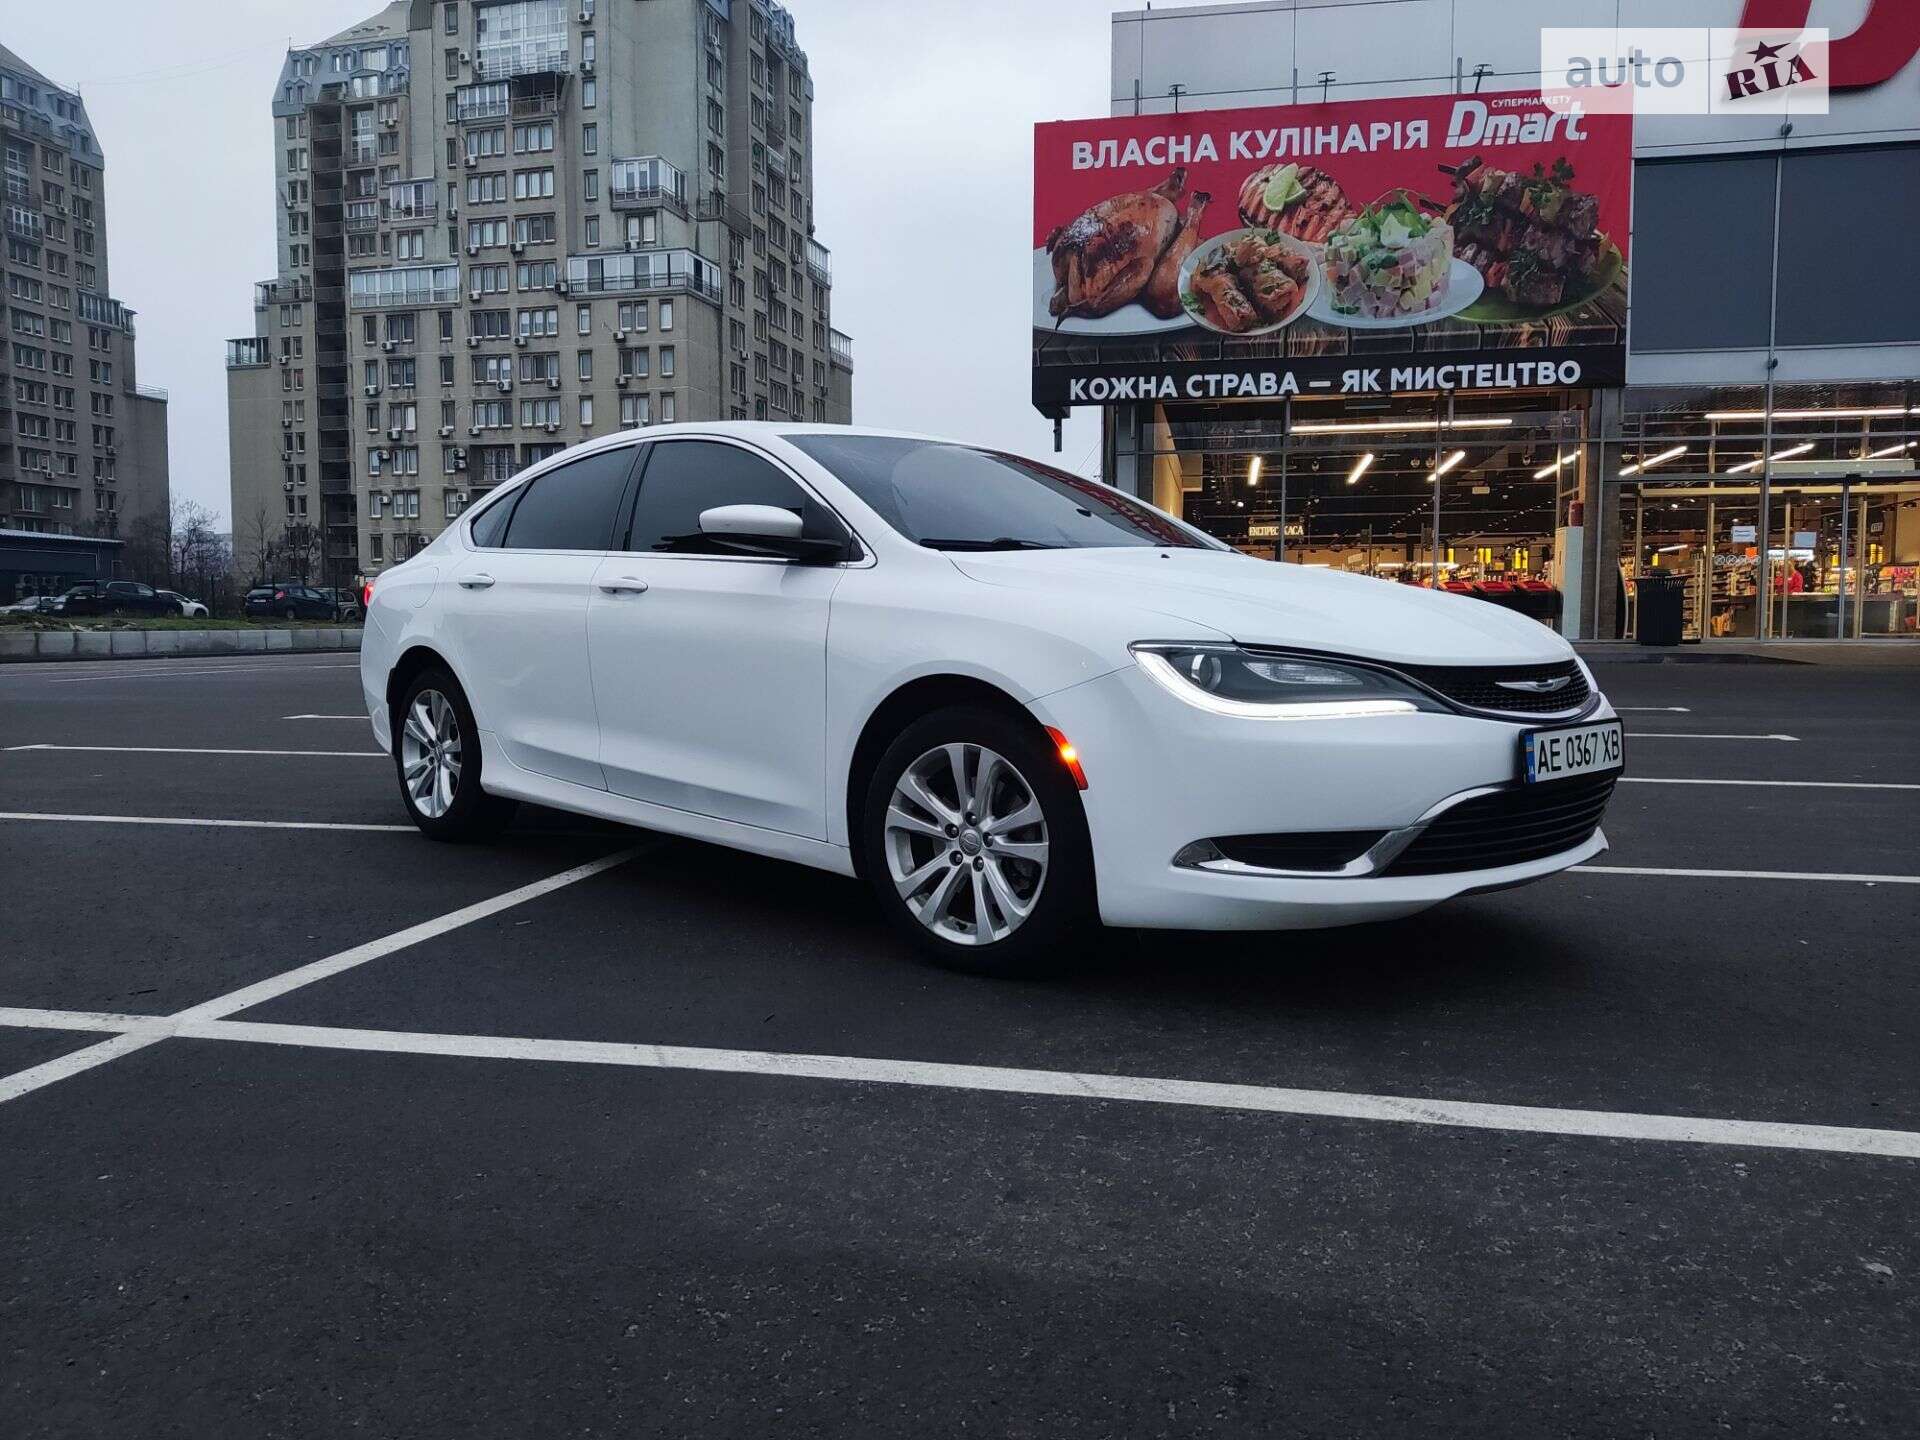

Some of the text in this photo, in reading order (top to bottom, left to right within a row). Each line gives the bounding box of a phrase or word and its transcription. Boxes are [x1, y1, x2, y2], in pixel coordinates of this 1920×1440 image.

[1491, 95, 1572, 108] СУПЕРМАРКЕТУ
[1072, 119, 1429, 170] ВЛАСНА КУЛІНАРІЯ
[1069, 375, 1178, 401] КОЖНА
[1186, 371, 1300, 398] СТРАВА
[1340, 368, 1382, 393] ЯК
[1390, 360, 1581, 391] МИСТЕЦТВО
[1538, 729, 1620, 774] AE 0367 XB
